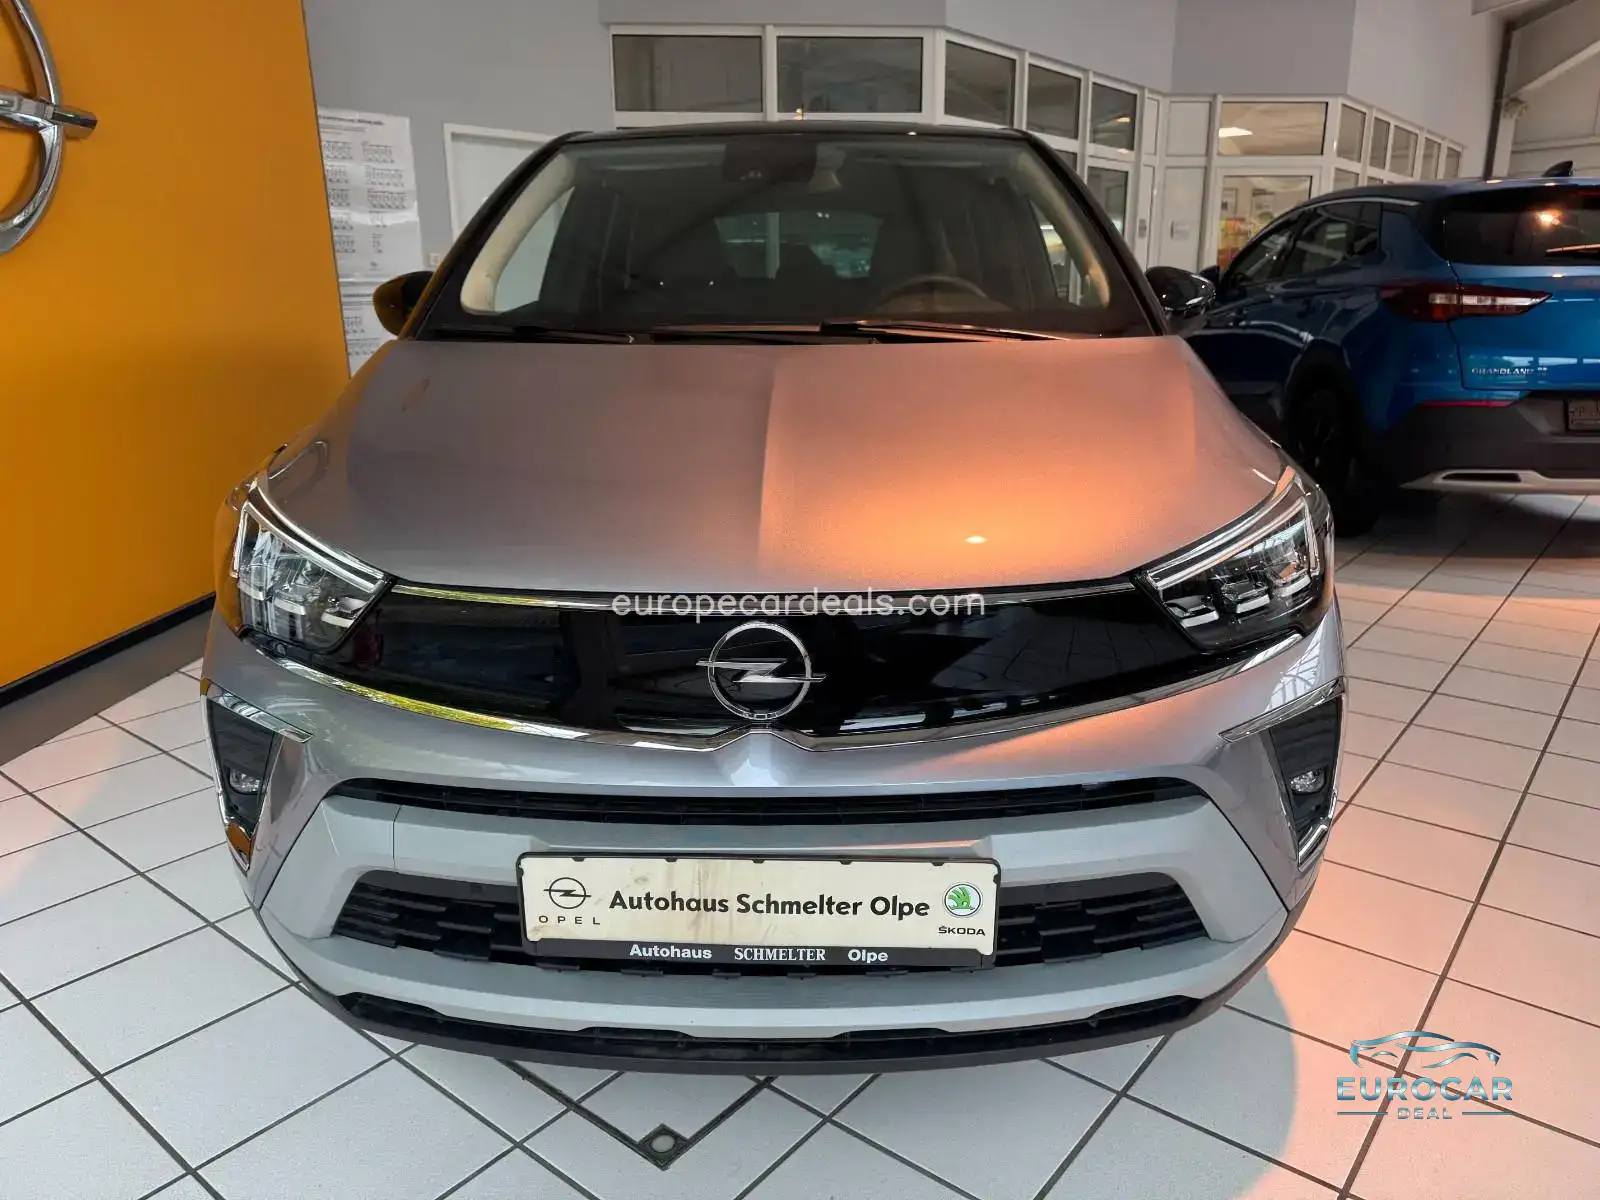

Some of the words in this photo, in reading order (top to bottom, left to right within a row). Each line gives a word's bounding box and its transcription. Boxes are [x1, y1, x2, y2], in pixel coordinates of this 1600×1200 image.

[609, 890, 729, 914] Autohaus
[736, 893, 863, 917] Schmelter
[869, 897, 931, 920] Olpe
[538, 914, 601, 926] OPEL
[938, 924, 987, 937] ŠKODA
[629, 944, 713, 960] Autohaus
[734, 946, 827, 962] SCHMELTER
[847, 948, 889, 964] Olpe
